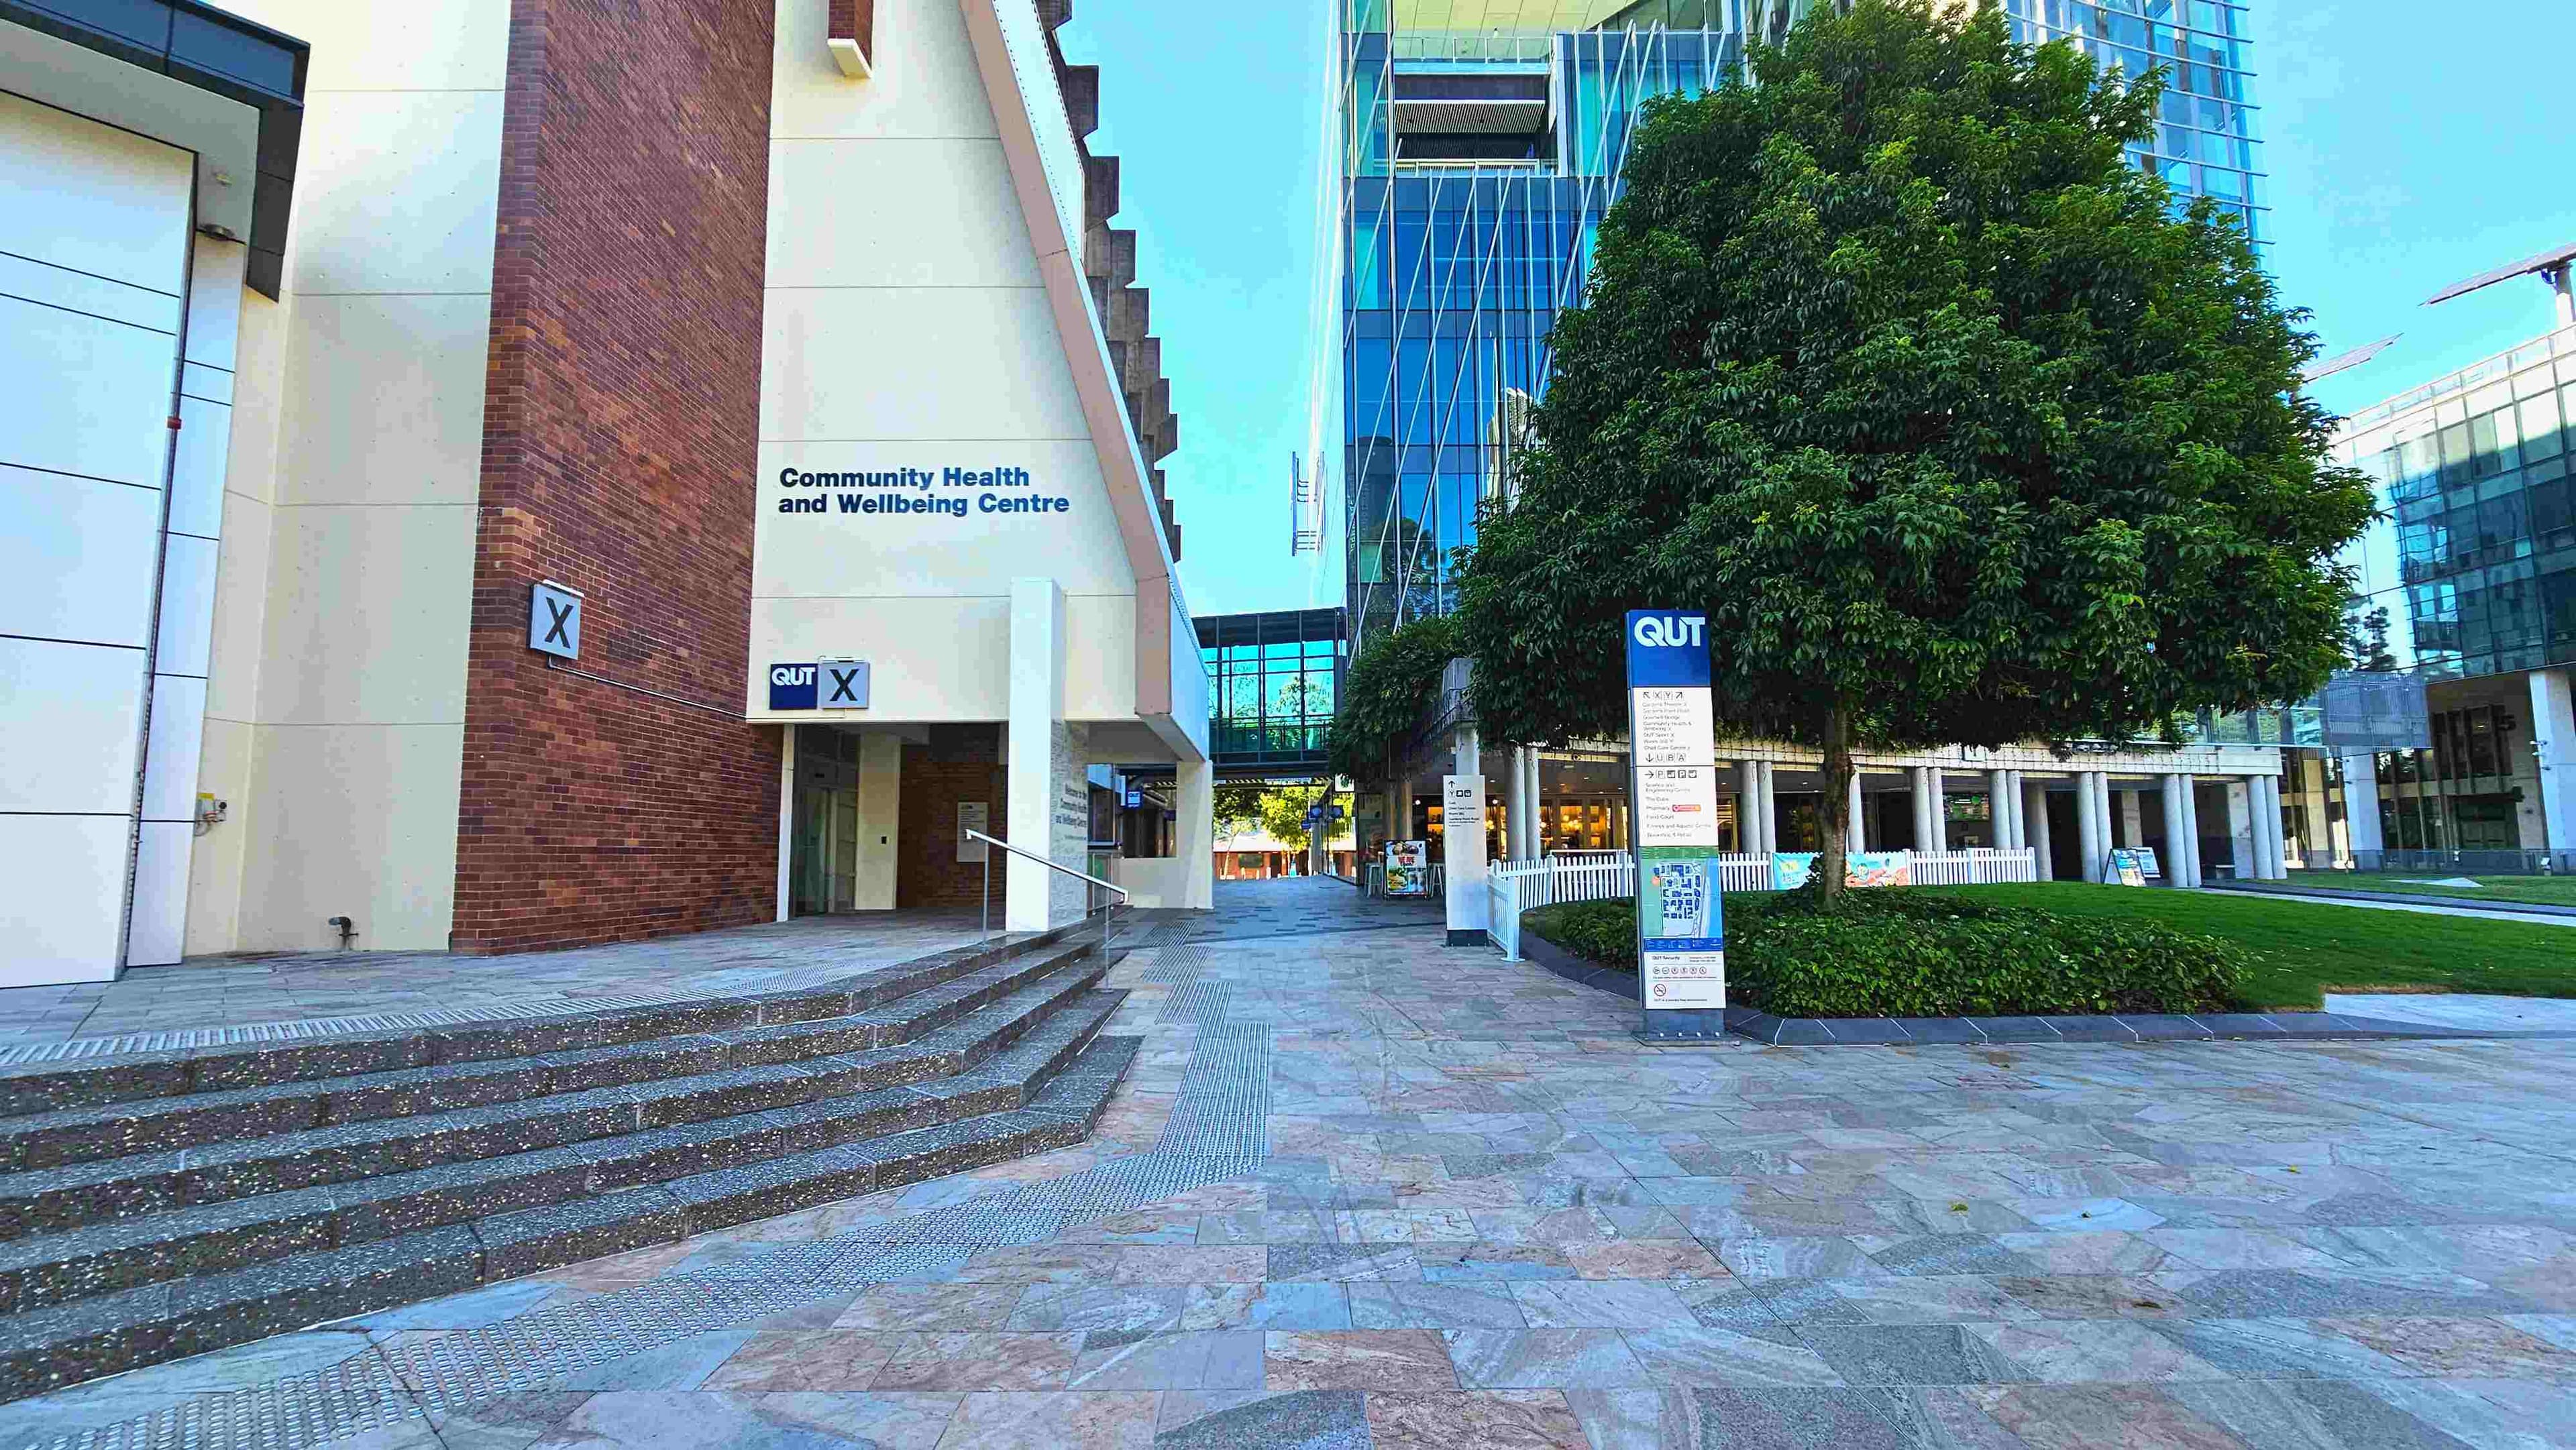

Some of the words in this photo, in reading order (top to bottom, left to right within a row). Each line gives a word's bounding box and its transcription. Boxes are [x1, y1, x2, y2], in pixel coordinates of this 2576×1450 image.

[780, 467, 934, 491] Community
[943, 467, 1030, 486] Health
[778, 494, 827, 513] and
[837, 493, 967, 516] Wellbeing
[979, 493, 1070, 513] Centre
[545, 596, 574, 649] X
[1634, 616, 1705, 647] QUT
[771, 667, 816, 686] QUT
[829, 669, 859, 702] X
